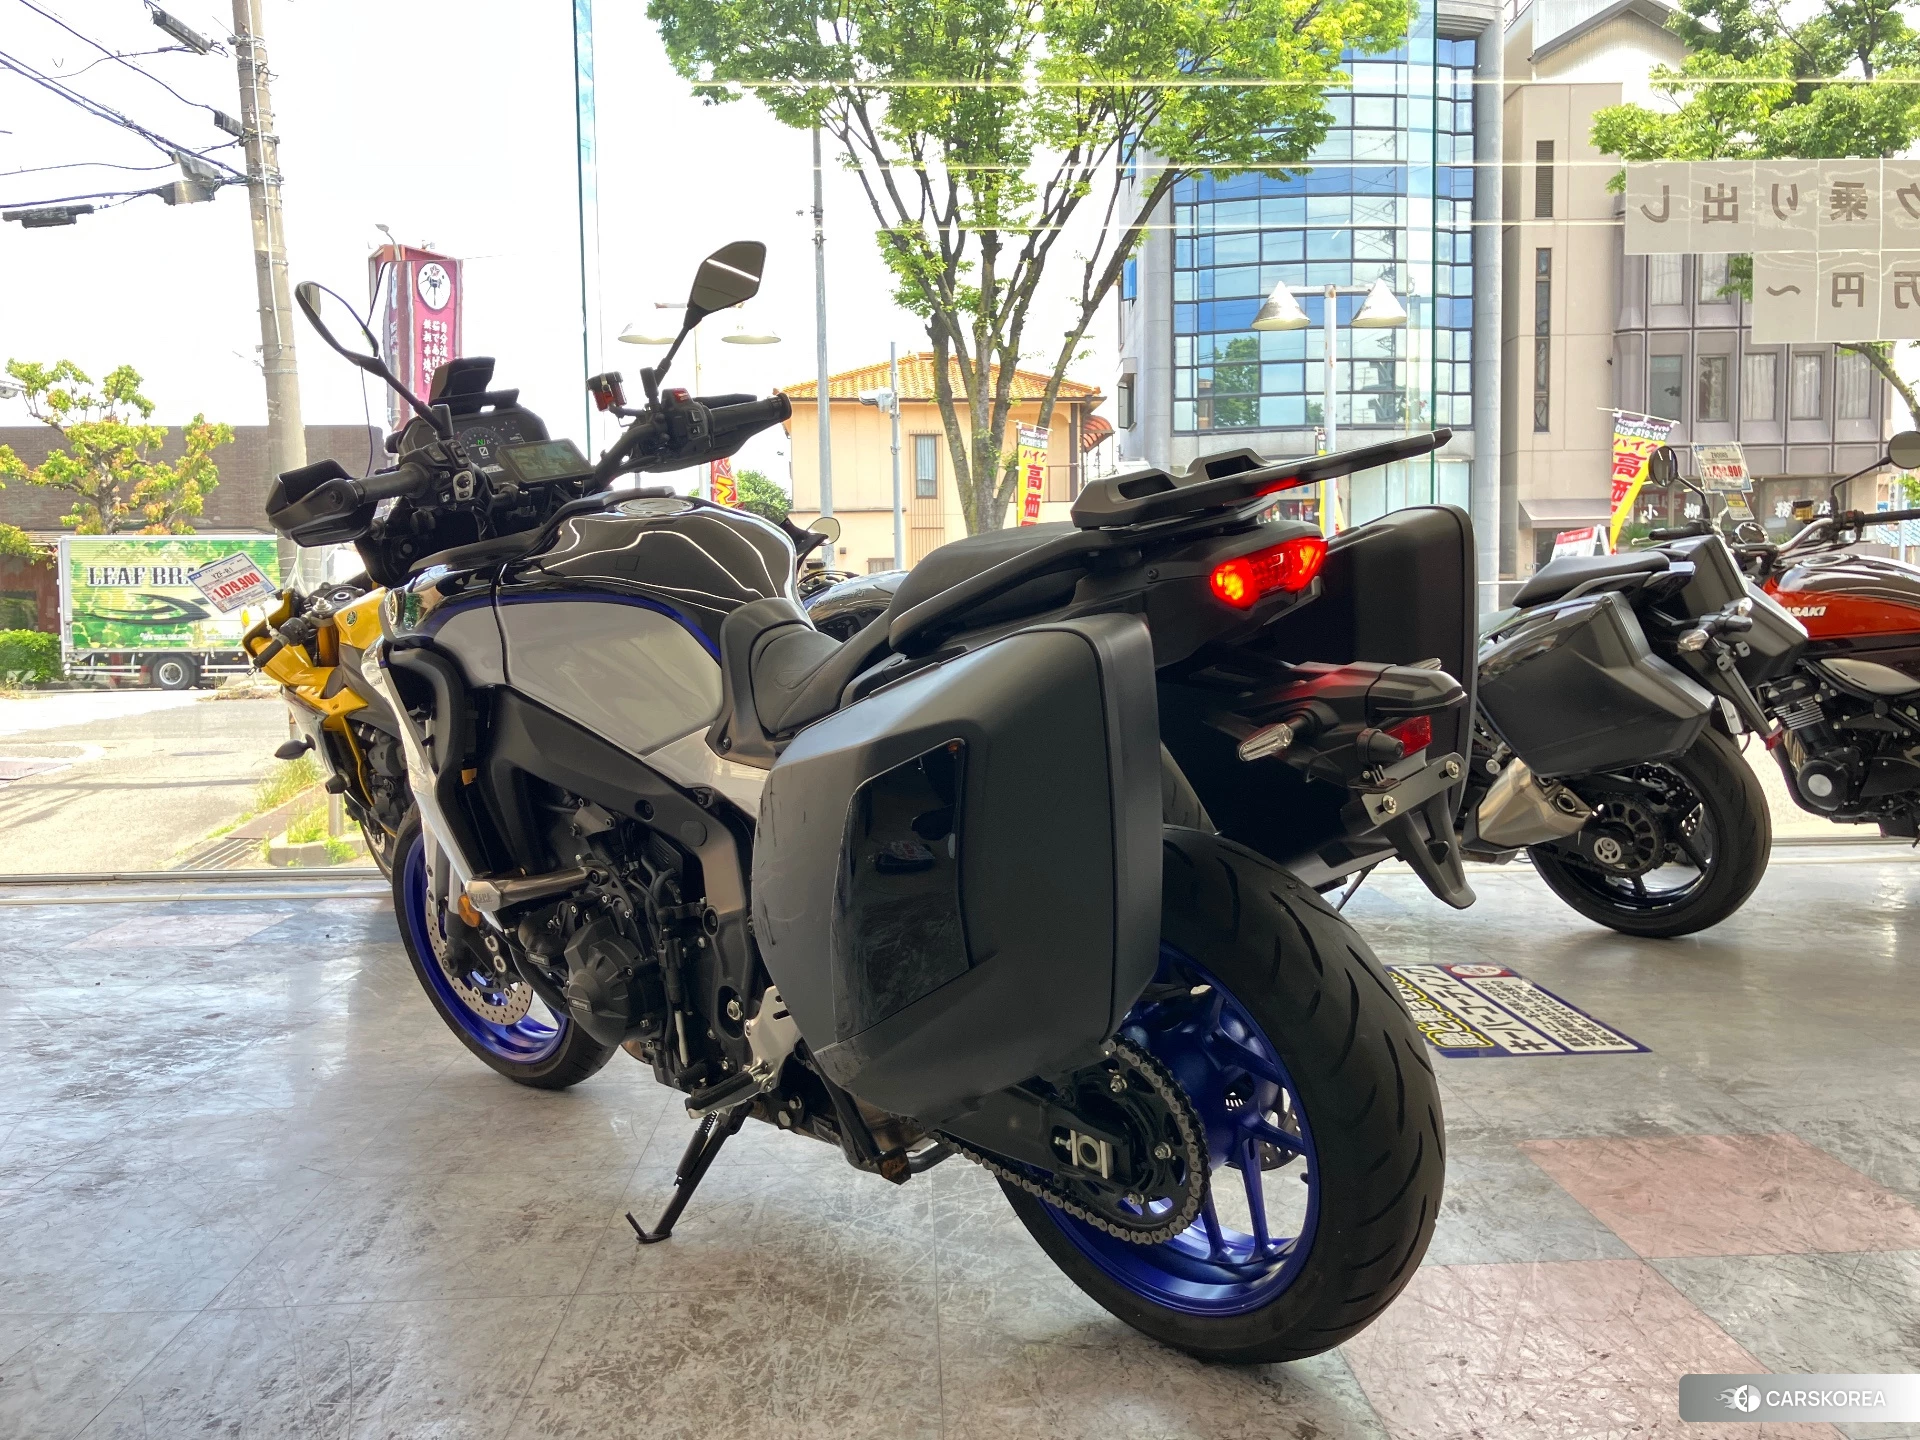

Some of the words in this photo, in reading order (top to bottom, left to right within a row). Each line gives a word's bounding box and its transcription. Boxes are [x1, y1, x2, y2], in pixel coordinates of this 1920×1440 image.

[88, 566, 146, 585] LEAF
[210, 566, 234, 580] YZF-R1
[212, 572, 261, 599] 1,079,900
[1398, 968, 1549, 1049] キーパーコーティング
